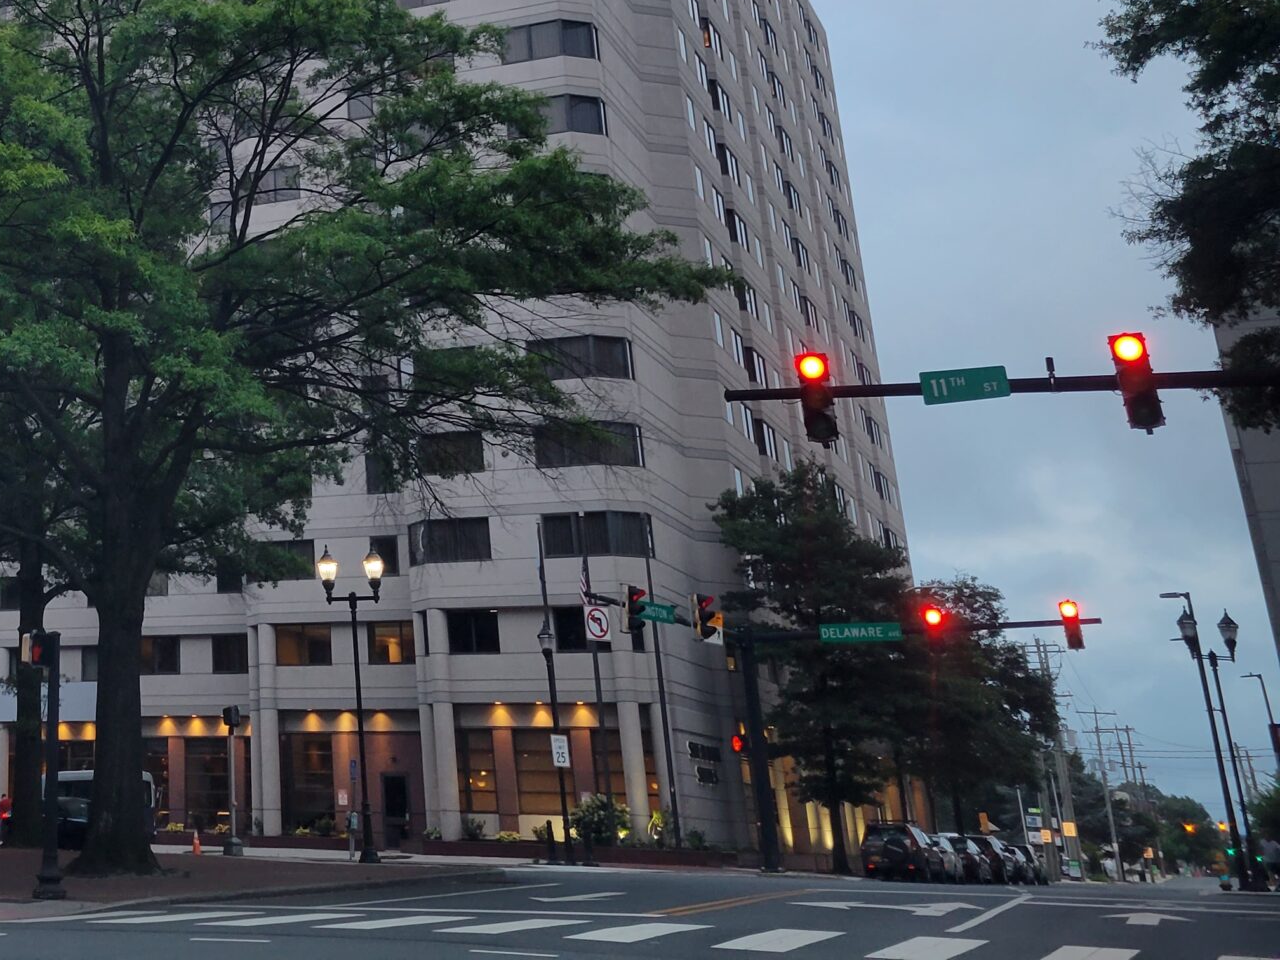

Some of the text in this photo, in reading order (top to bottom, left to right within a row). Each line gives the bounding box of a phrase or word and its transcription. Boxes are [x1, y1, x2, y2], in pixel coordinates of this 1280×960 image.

[930, 376, 998, 397] 11TH ST
[821, 626, 884, 638] DELAWARE
[556, 751, 566, 763] 25
